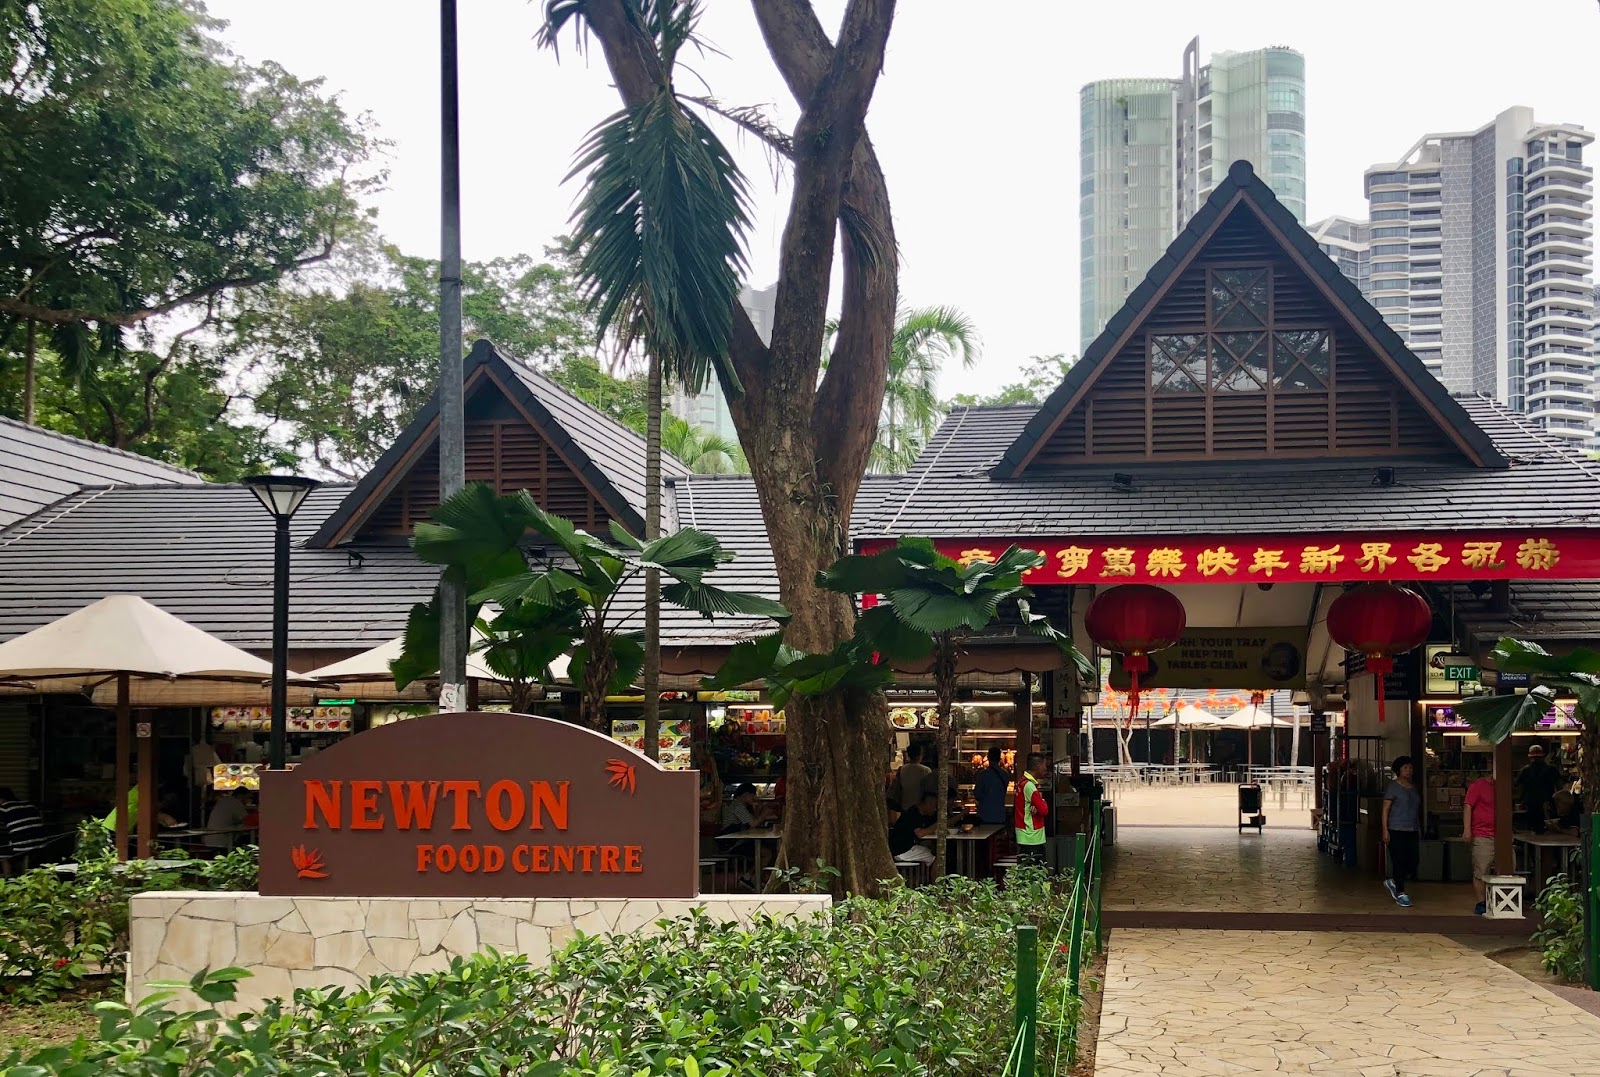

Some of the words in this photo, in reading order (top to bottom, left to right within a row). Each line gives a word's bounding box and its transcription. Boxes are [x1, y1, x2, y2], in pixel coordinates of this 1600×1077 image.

[1200, 638, 1232, 647] YOUR
[1237, 638, 1267, 647] TRAY
[1181, 649, 1209, 658] KEEP
[1213, 649, 1234, 658] THE
[1167, 660, 1207, 669] TABLES
[1210, 660, 1248, 669] CLEAN
[1449, 667, 1472, 679] EXIT
[303, 779, 570, 831] NEWTON
[416, 844, 506, 873] FOOD
[512, 844, 643, 873] CENTRE
